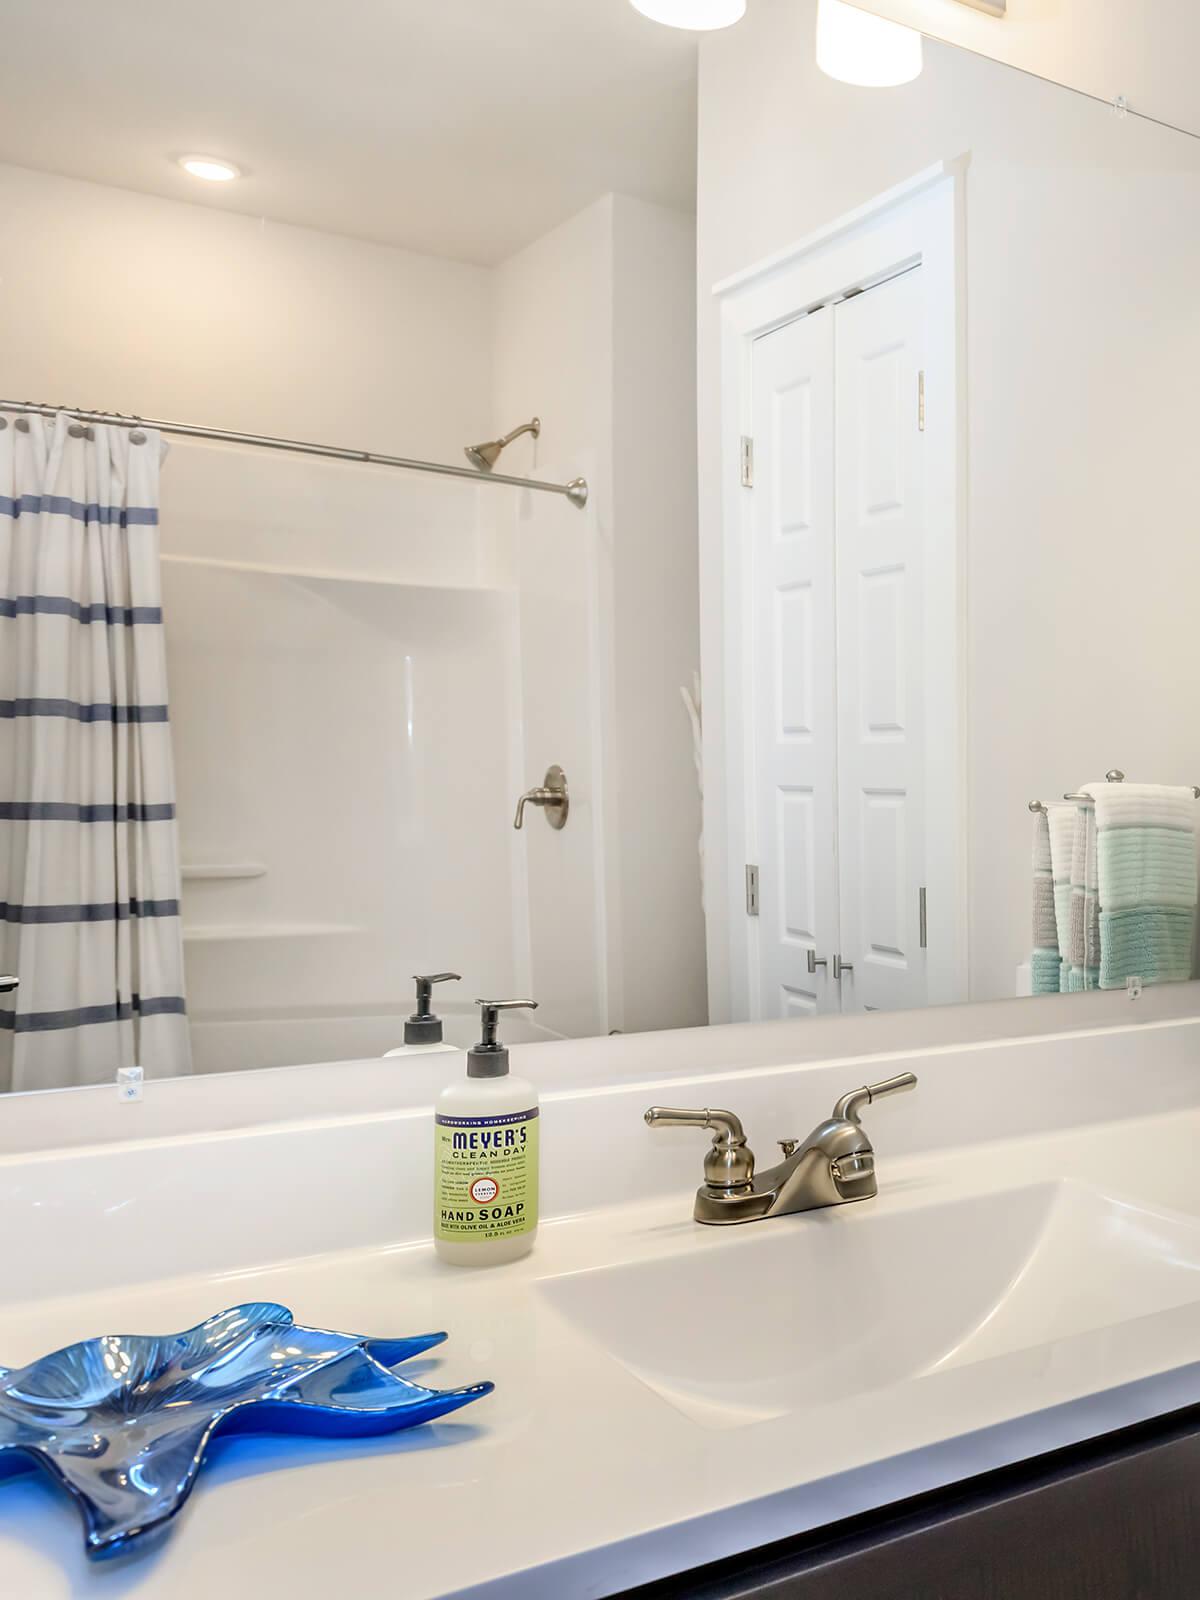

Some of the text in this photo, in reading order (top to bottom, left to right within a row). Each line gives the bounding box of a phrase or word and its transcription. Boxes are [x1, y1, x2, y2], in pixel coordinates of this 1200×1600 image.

[453, 1126, 526, 1149] MEYER'S
[452, 1145, 526, 1159] CLEAN DAY
[441, 1203, 524, 1222] HAND SOAP
[512, 1216, 526, 1224] VERA
